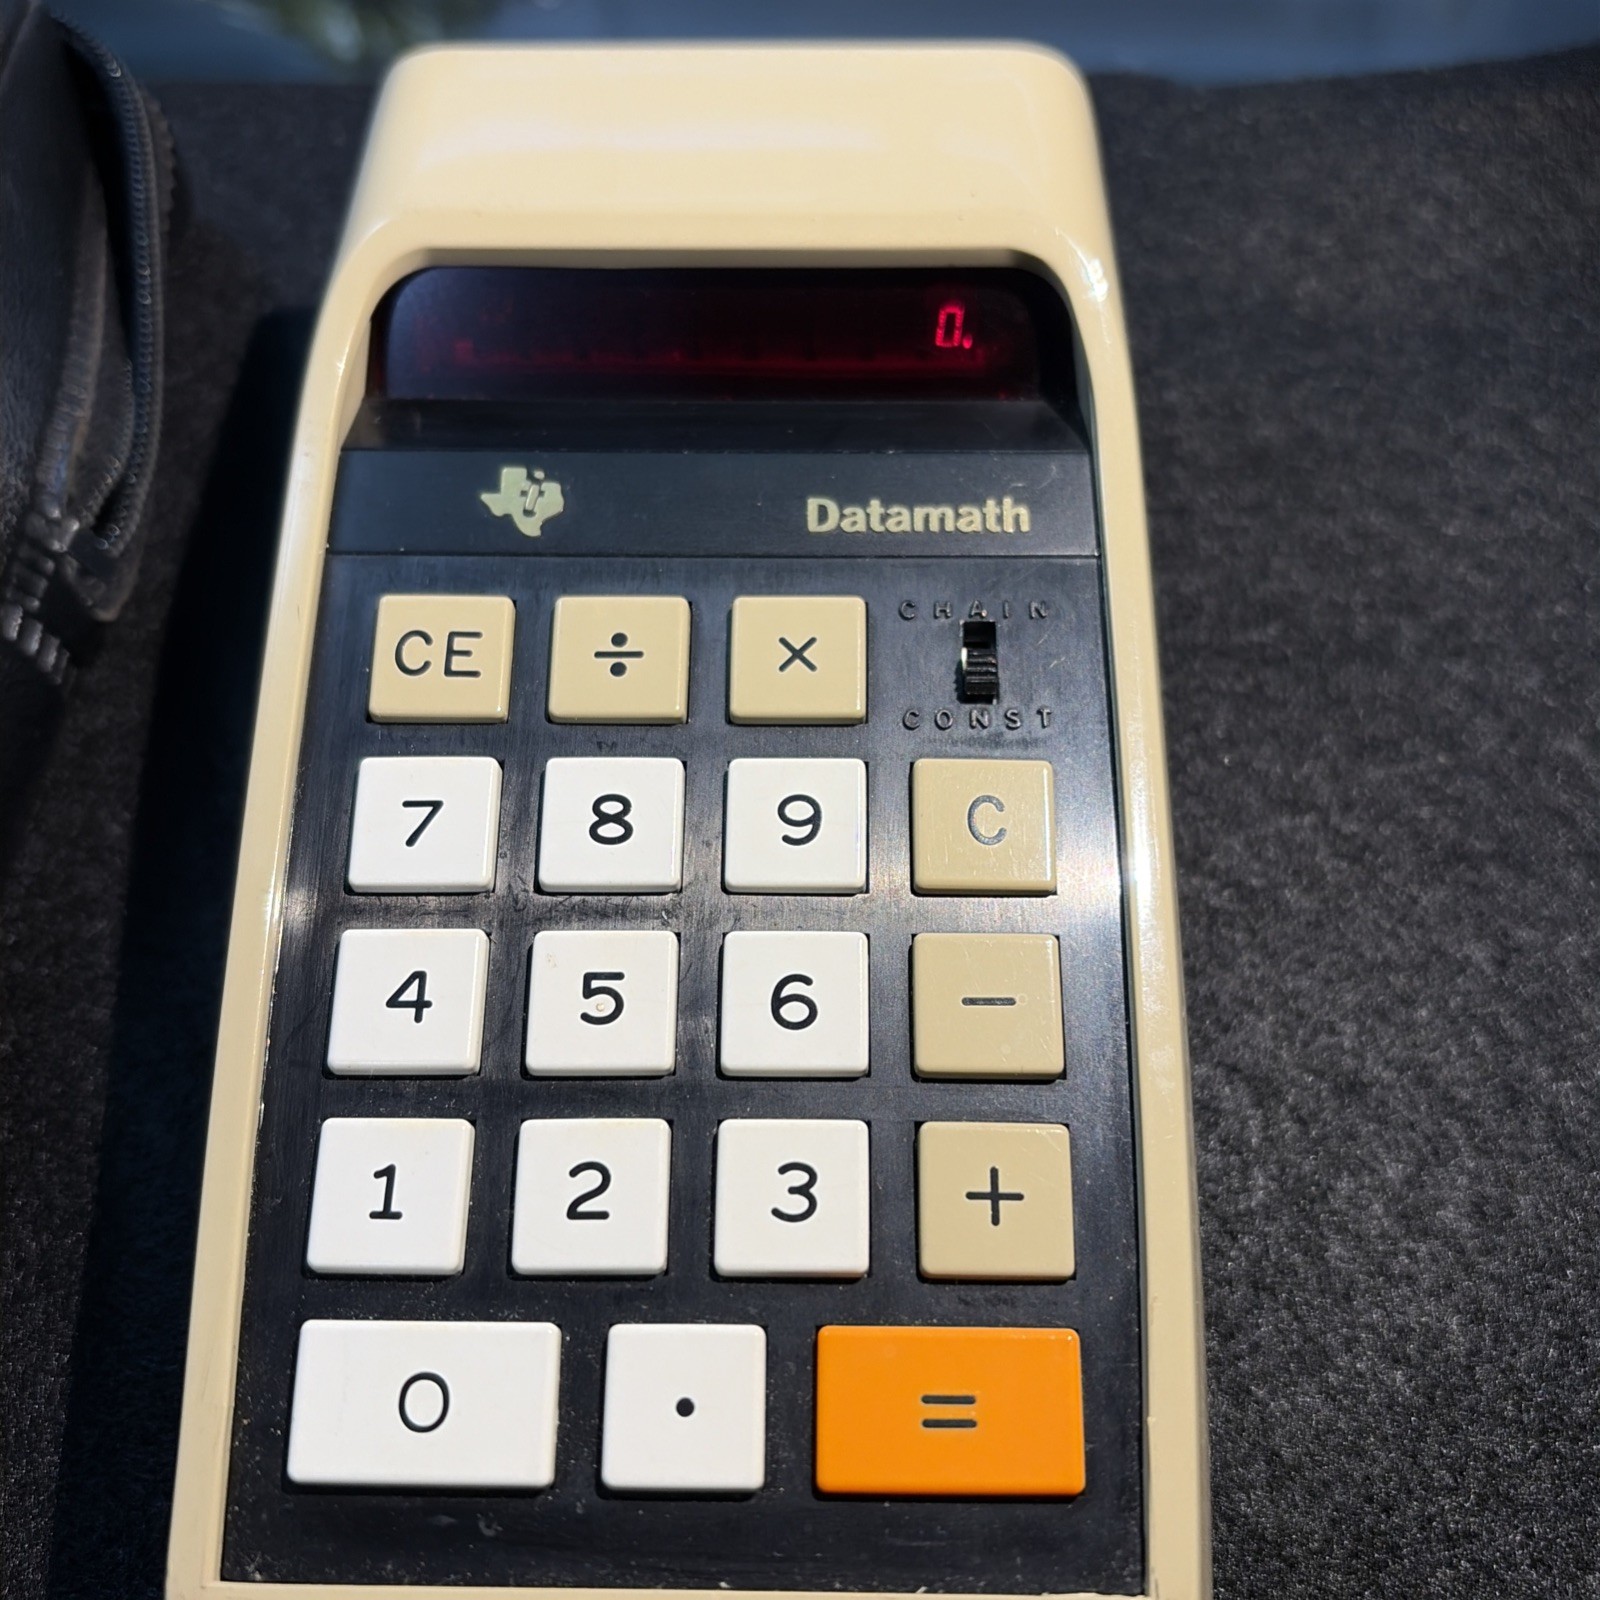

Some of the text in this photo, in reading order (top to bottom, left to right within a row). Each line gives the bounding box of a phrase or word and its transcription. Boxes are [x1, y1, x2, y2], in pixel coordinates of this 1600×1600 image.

[935, 303, 973, 349] 0.
[806, 496, 1031, 533] Datamath
[899, 600, 1048, 621] CHAIN
[395, 630, 482, 678] CE
[903, 707, 1052, 731] CONST
[402, 800, 443, 847] 7
[589, 794, 633, 845] 8
[778, 794, 822, 846] 9
[967, 795, 1006, 845] C
[386, 971, 432, 1023] 4
[580, 972, 625, 1025] 5
[771, 974, 818, 1030] 6
[369, 1164, 402, 1220] 1
[566, 1161, 611, 1220] 2
[771, 1162, 817, 1223] 3
[398, 1371, 450, 1433] 0
